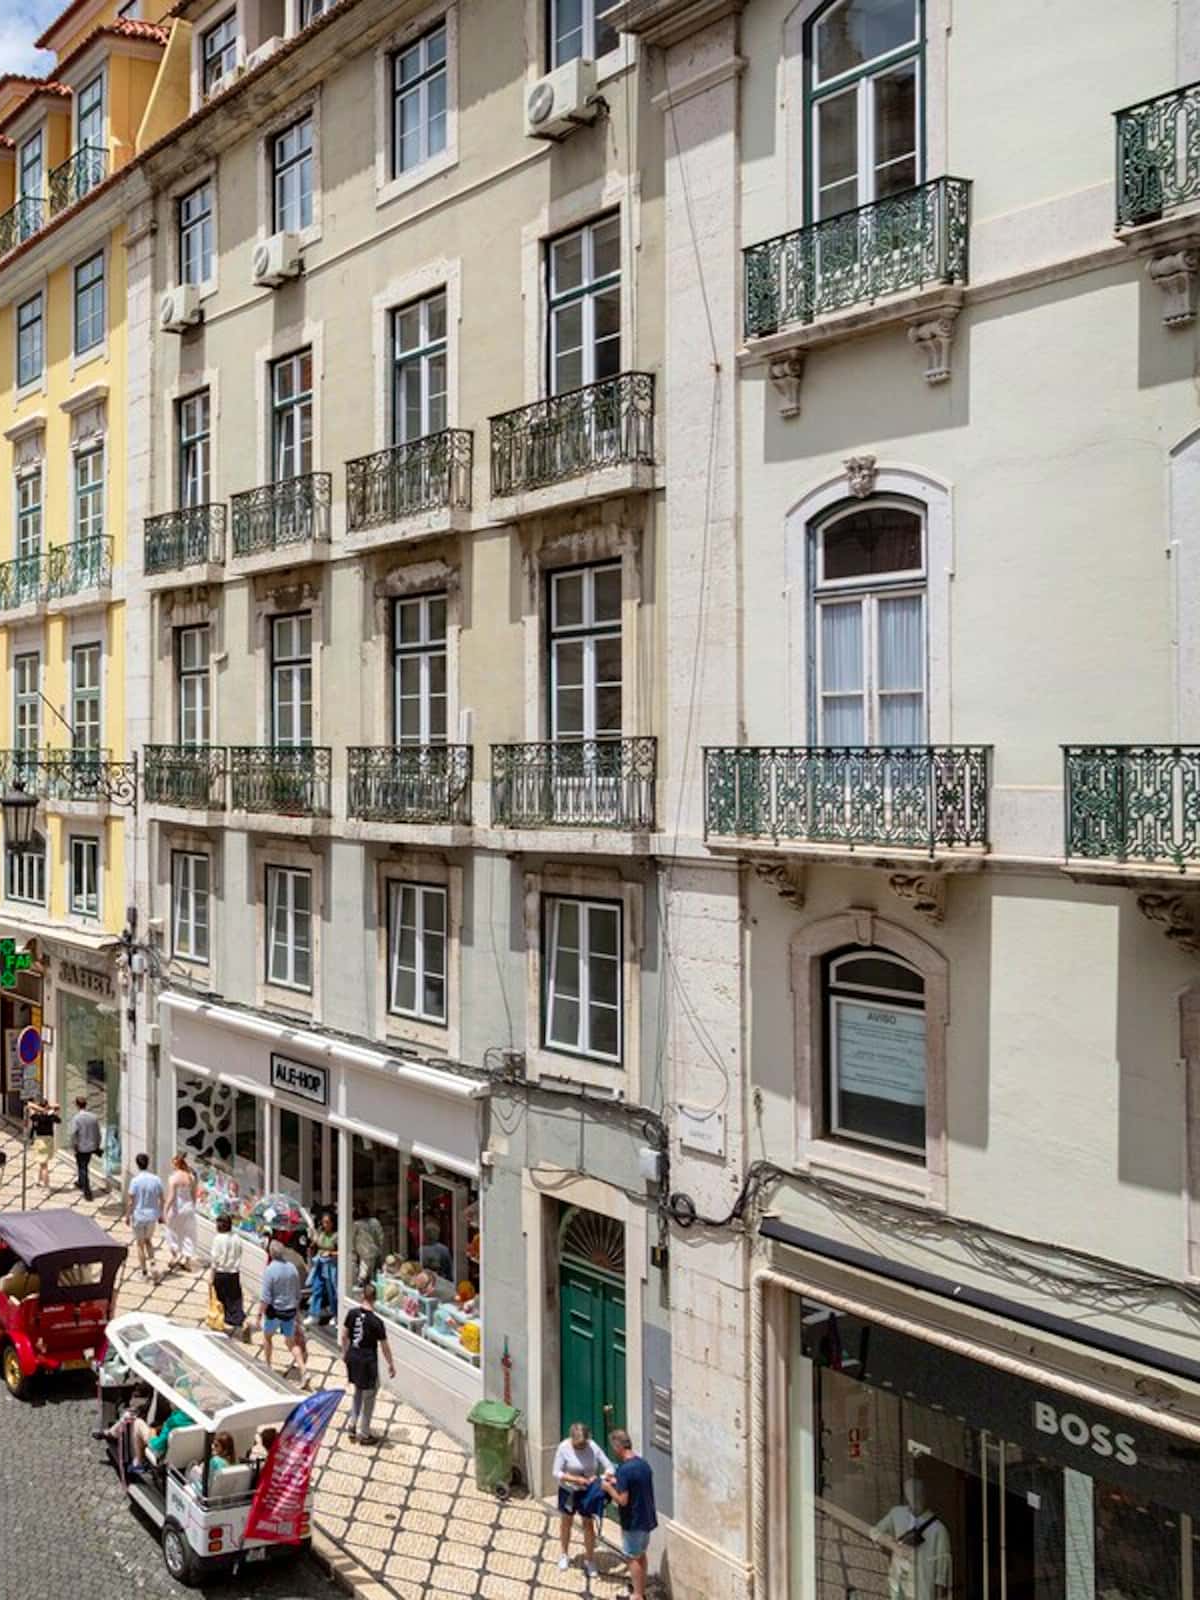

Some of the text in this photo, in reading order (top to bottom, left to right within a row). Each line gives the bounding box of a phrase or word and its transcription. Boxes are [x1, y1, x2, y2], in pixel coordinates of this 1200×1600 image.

[866, 1012, 897, 1025] AVISO
[276, 1063, 321, 1092] ALE-HOP
[1034, 1401, 1138, 1466] BOSS
